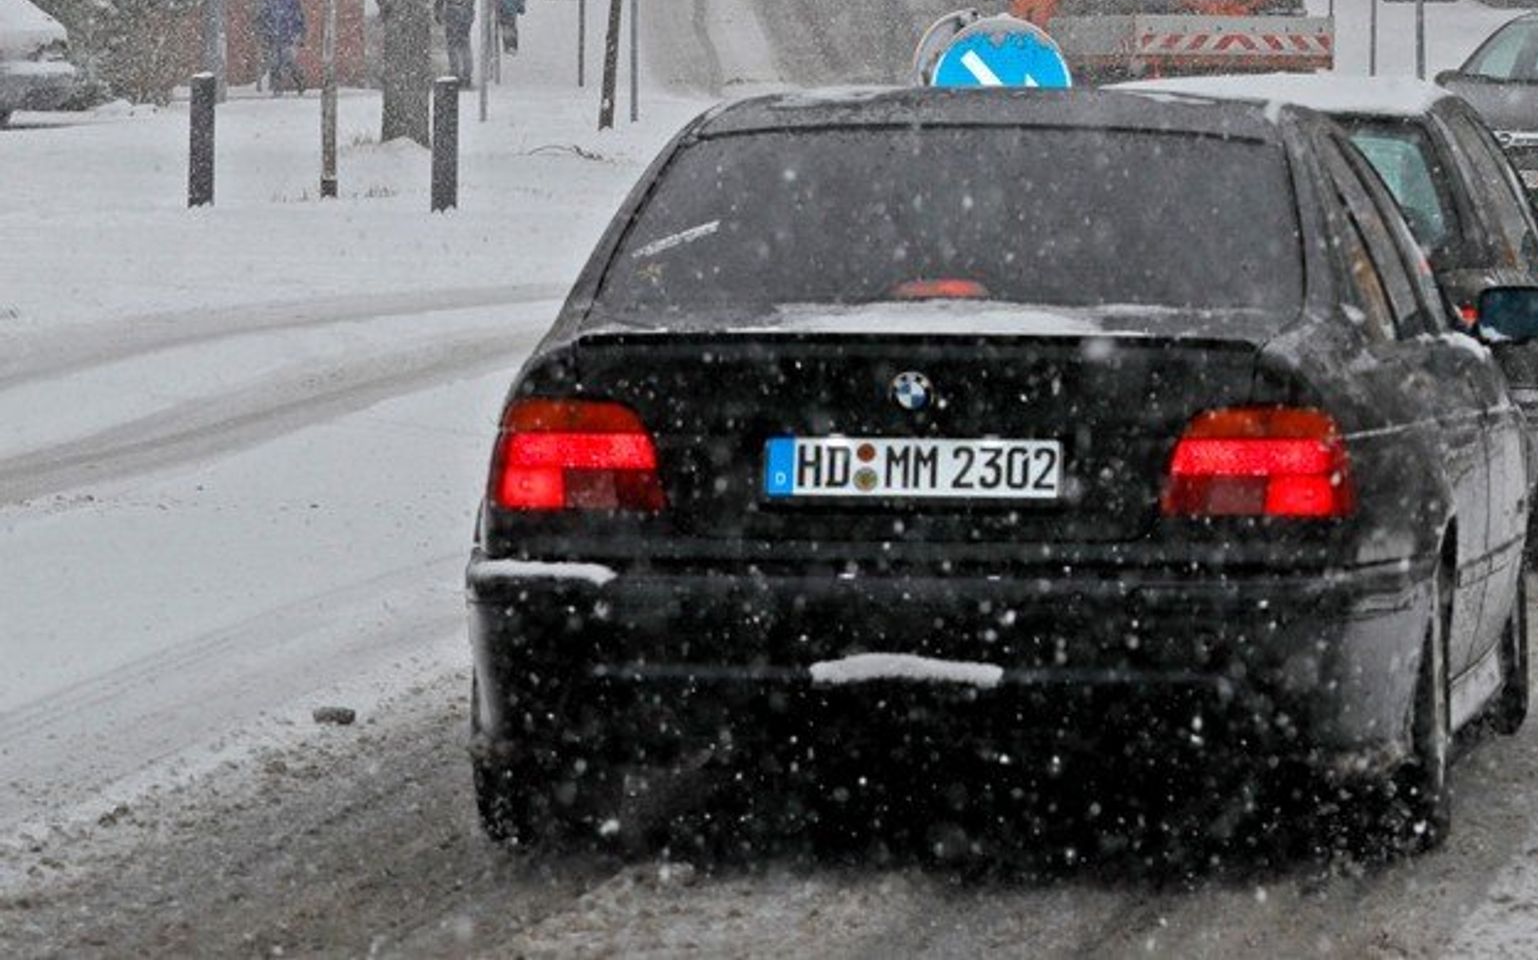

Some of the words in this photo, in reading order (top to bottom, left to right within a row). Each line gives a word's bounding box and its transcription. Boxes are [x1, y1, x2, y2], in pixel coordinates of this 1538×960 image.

[796, 444, 849, 488] HD
[884, 445, 938, 488] MM
[951, 446, 1057, 489] 2302
